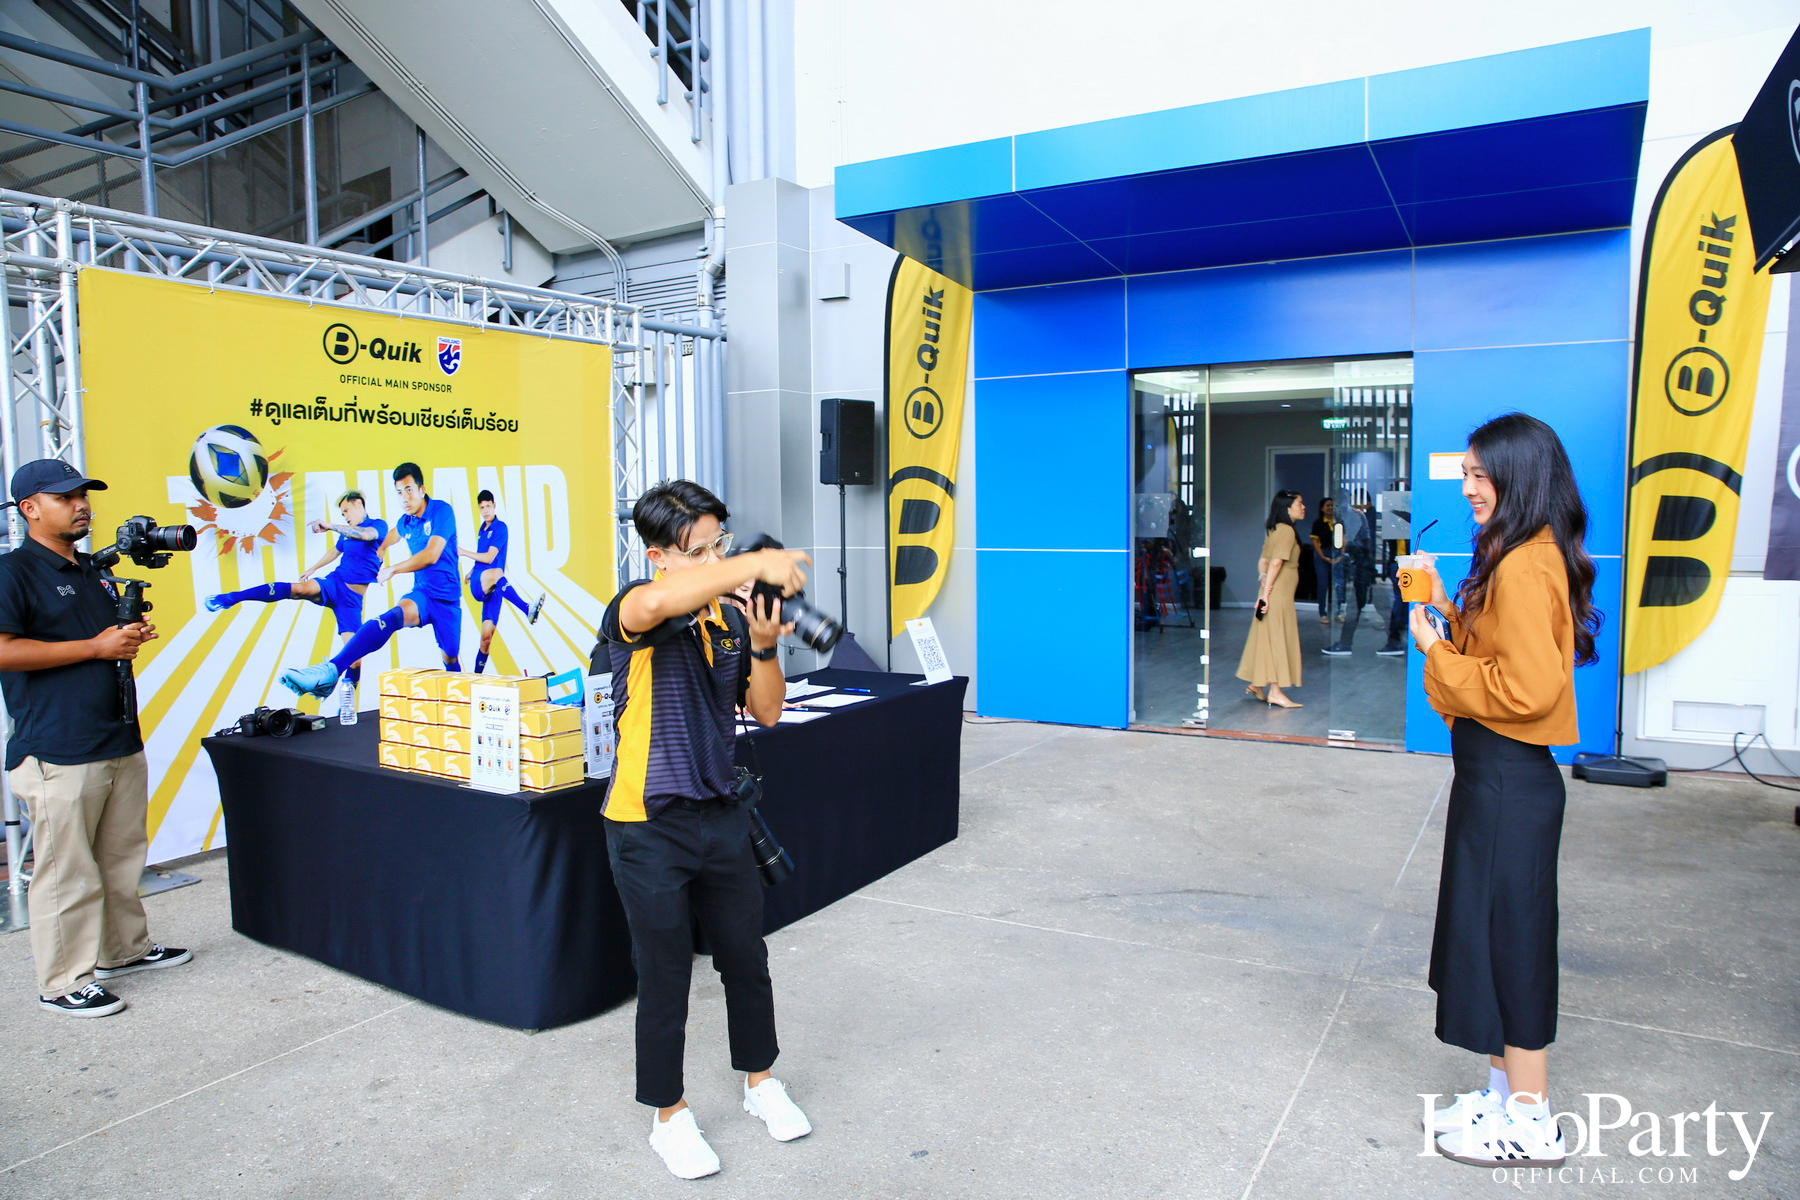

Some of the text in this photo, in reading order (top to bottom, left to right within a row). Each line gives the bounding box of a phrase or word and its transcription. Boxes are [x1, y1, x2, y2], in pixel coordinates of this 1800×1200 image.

[323, 323, 422, 365] B-Quik
[340, 374, 452, 393] OFFICIAL MAIN SPONSOR
